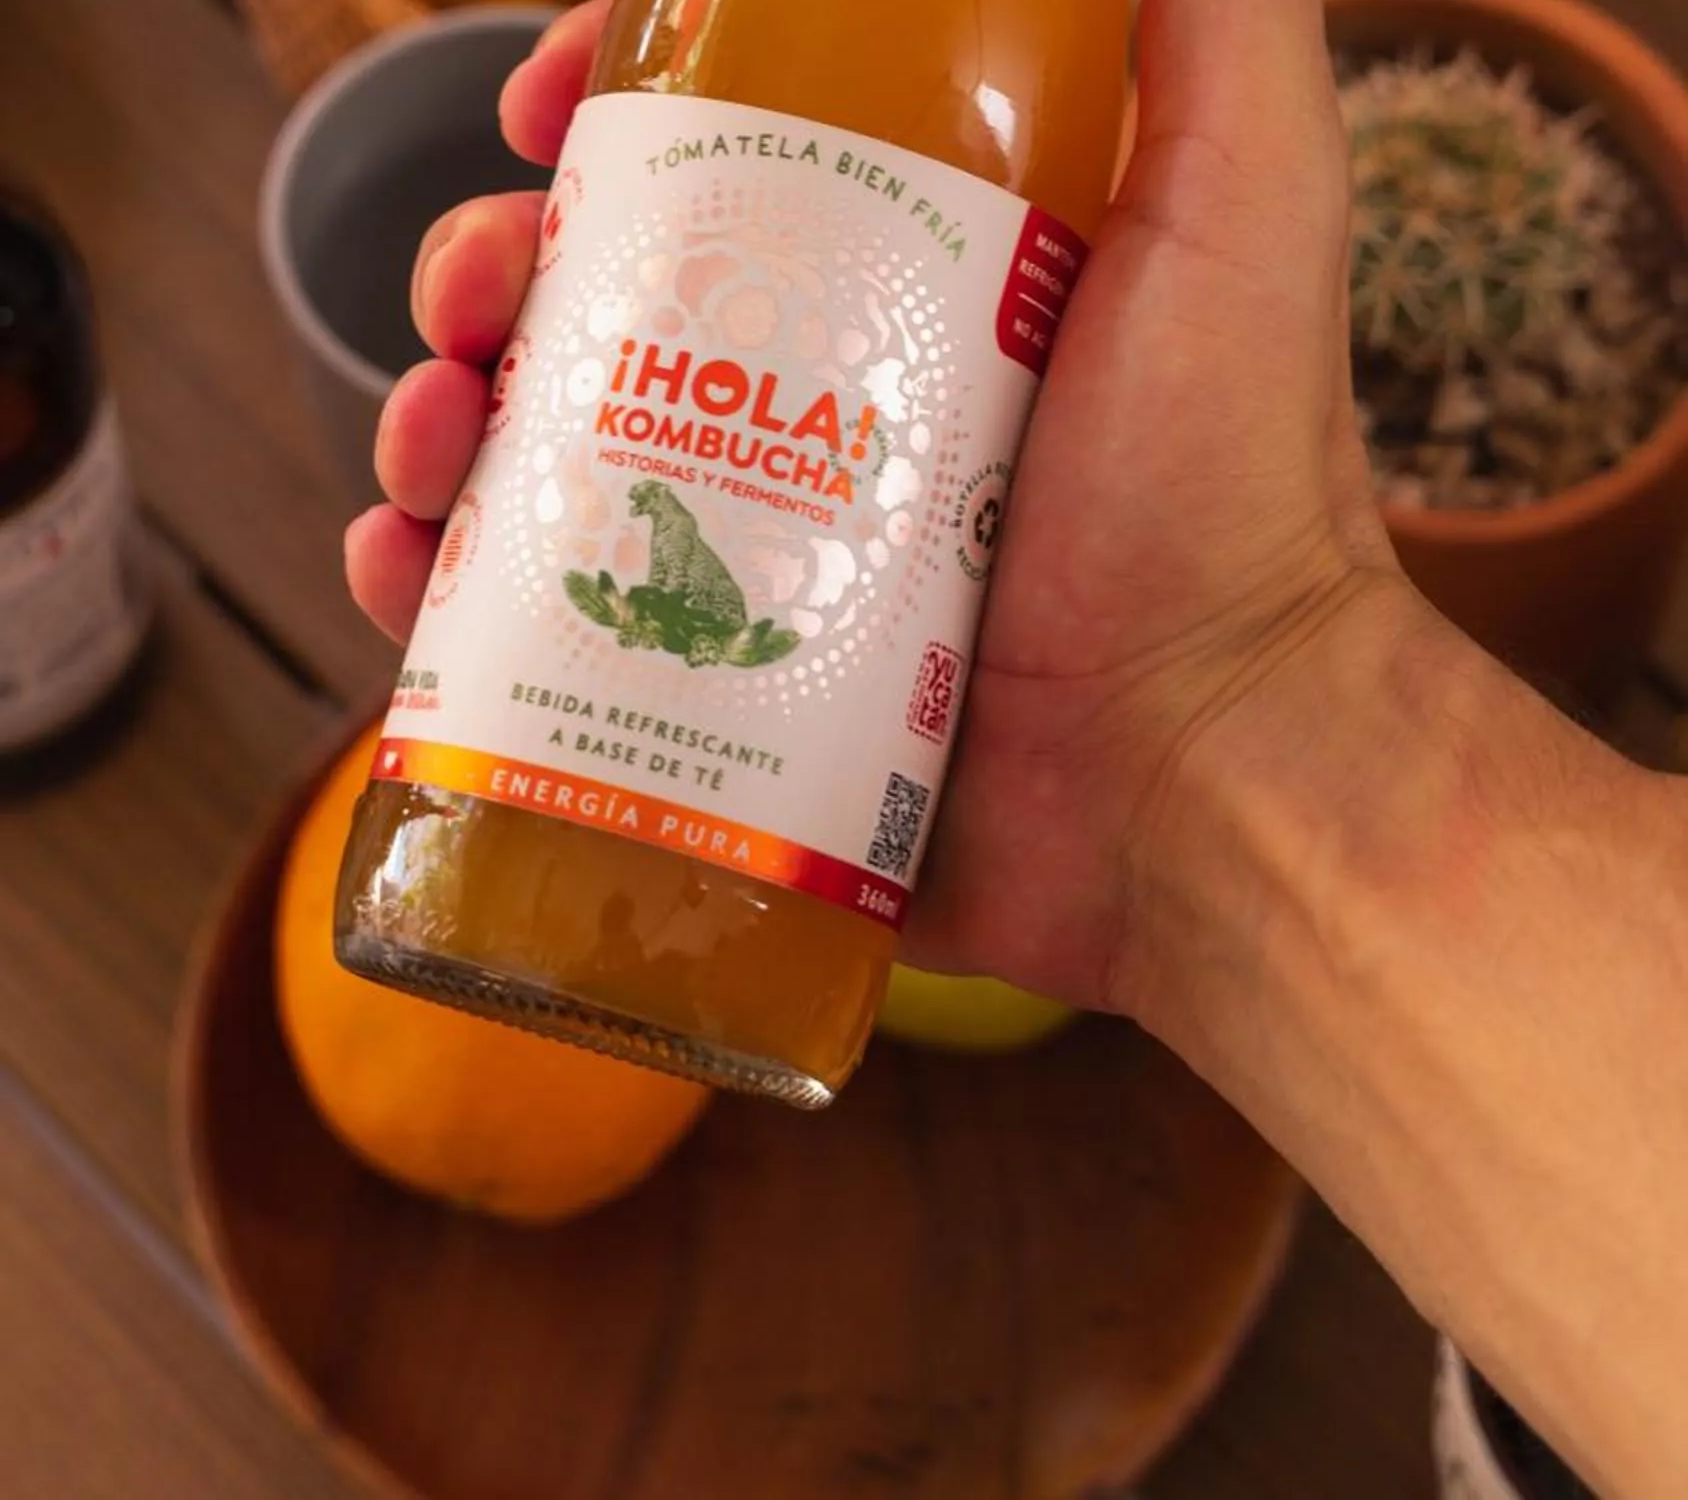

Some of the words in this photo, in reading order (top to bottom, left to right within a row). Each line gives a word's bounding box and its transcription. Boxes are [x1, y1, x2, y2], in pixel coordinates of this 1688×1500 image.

[645, 132, 819, 176] TÓMATELA
[834, 150, 907, 202] BIEN
[910, 196, 969, 263] FRÍA
[609, 338, 879, 463] ¡HOLA!
[595, 403, 854, 506] KOMBUCHA
[596, 446, 700, 484] HISTORIAS
[701, 471, 718, 488] Y
[718, 478, 836, 527] FERMENTOS
[949, 462, 992, 529] BOTELLA
[510, 680, 596, 720] BEBIDA
[606, 705, 787, 777] REFRESCANTE
[548, 728, 565, 746] A
[573, 733, 638, 767] BASE
[648, 750, 682, 776] DE
[694, 762, 725, 792] TÉ
[489, 767, 641, 830] ENERGÍA
[659, 815, 754, 865] PURA
